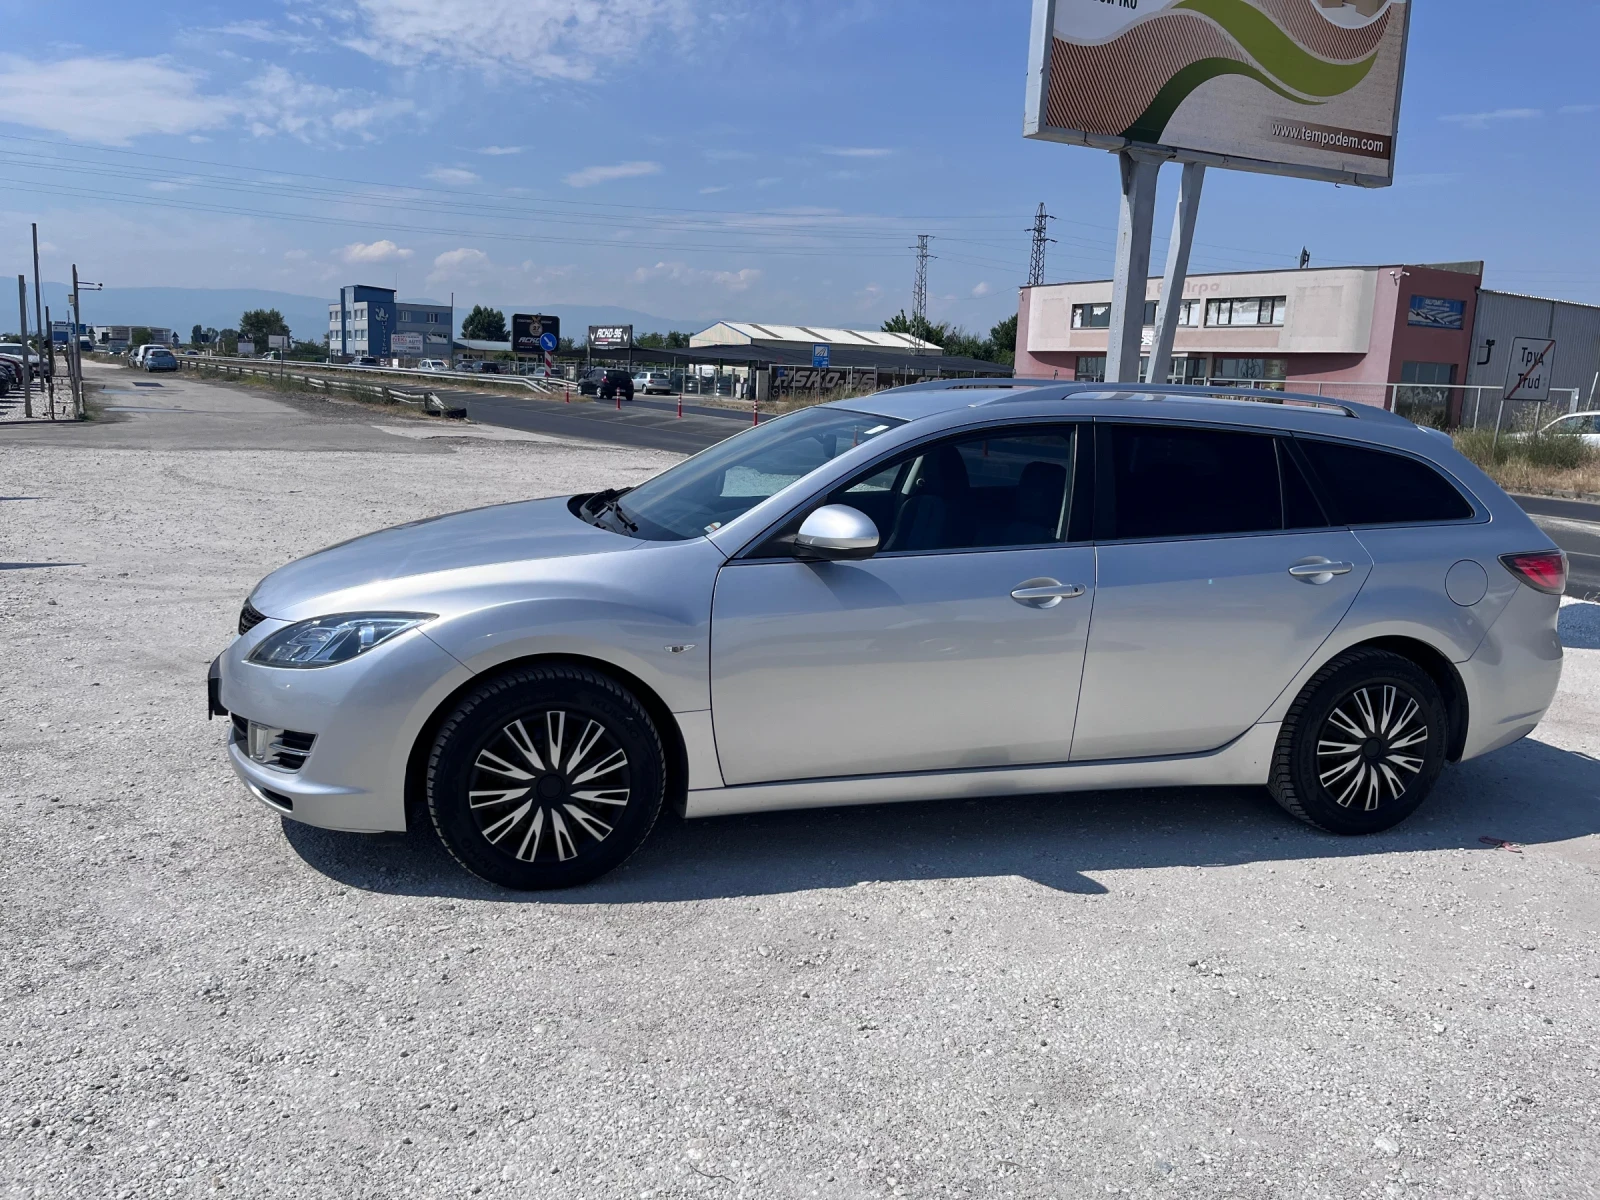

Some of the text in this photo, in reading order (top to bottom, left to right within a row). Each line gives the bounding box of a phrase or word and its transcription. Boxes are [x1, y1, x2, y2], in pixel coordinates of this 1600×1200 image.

[1271, 123, 1384, 153] www.tempodem.com
[1521, 346, 1545, 367] Труд
[1517, 372, 1541, 389] Trud
